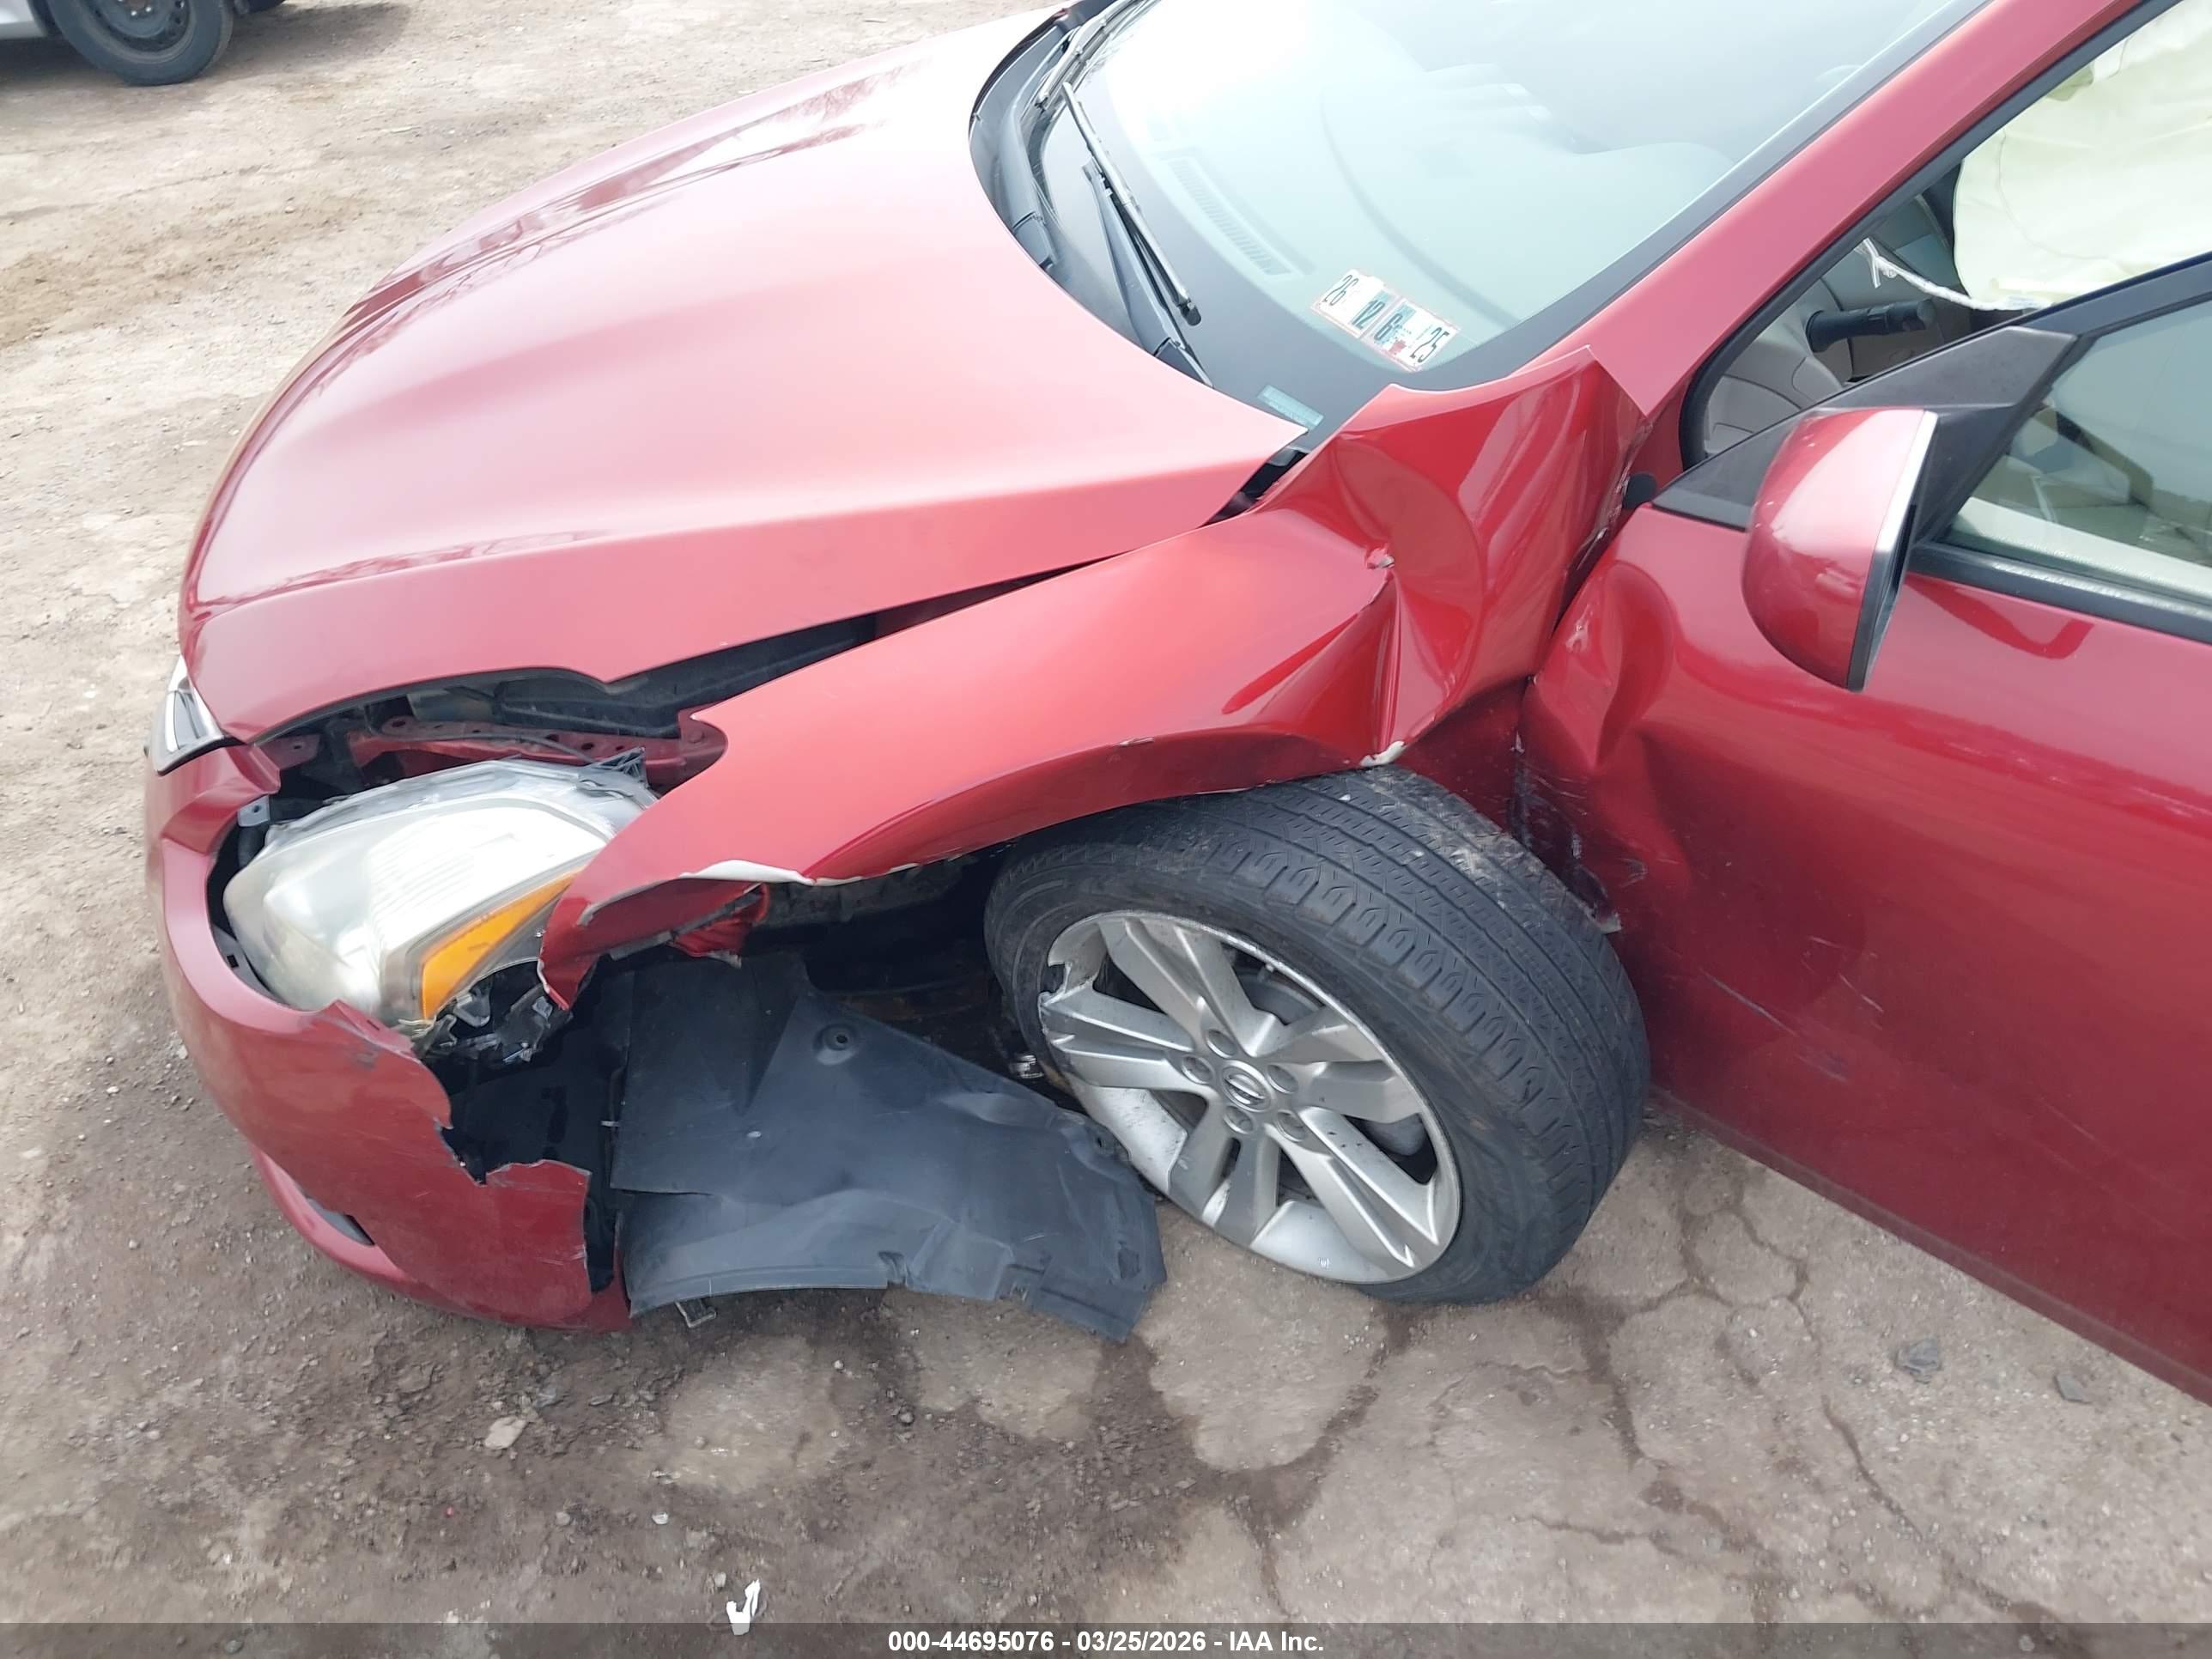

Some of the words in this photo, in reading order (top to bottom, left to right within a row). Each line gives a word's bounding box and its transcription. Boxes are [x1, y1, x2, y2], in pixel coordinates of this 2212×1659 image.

[1322, 274, 1359, 307] 26
[1352, 299, 1386, 331] 12
[1409, 326, 1449, 363] 25
